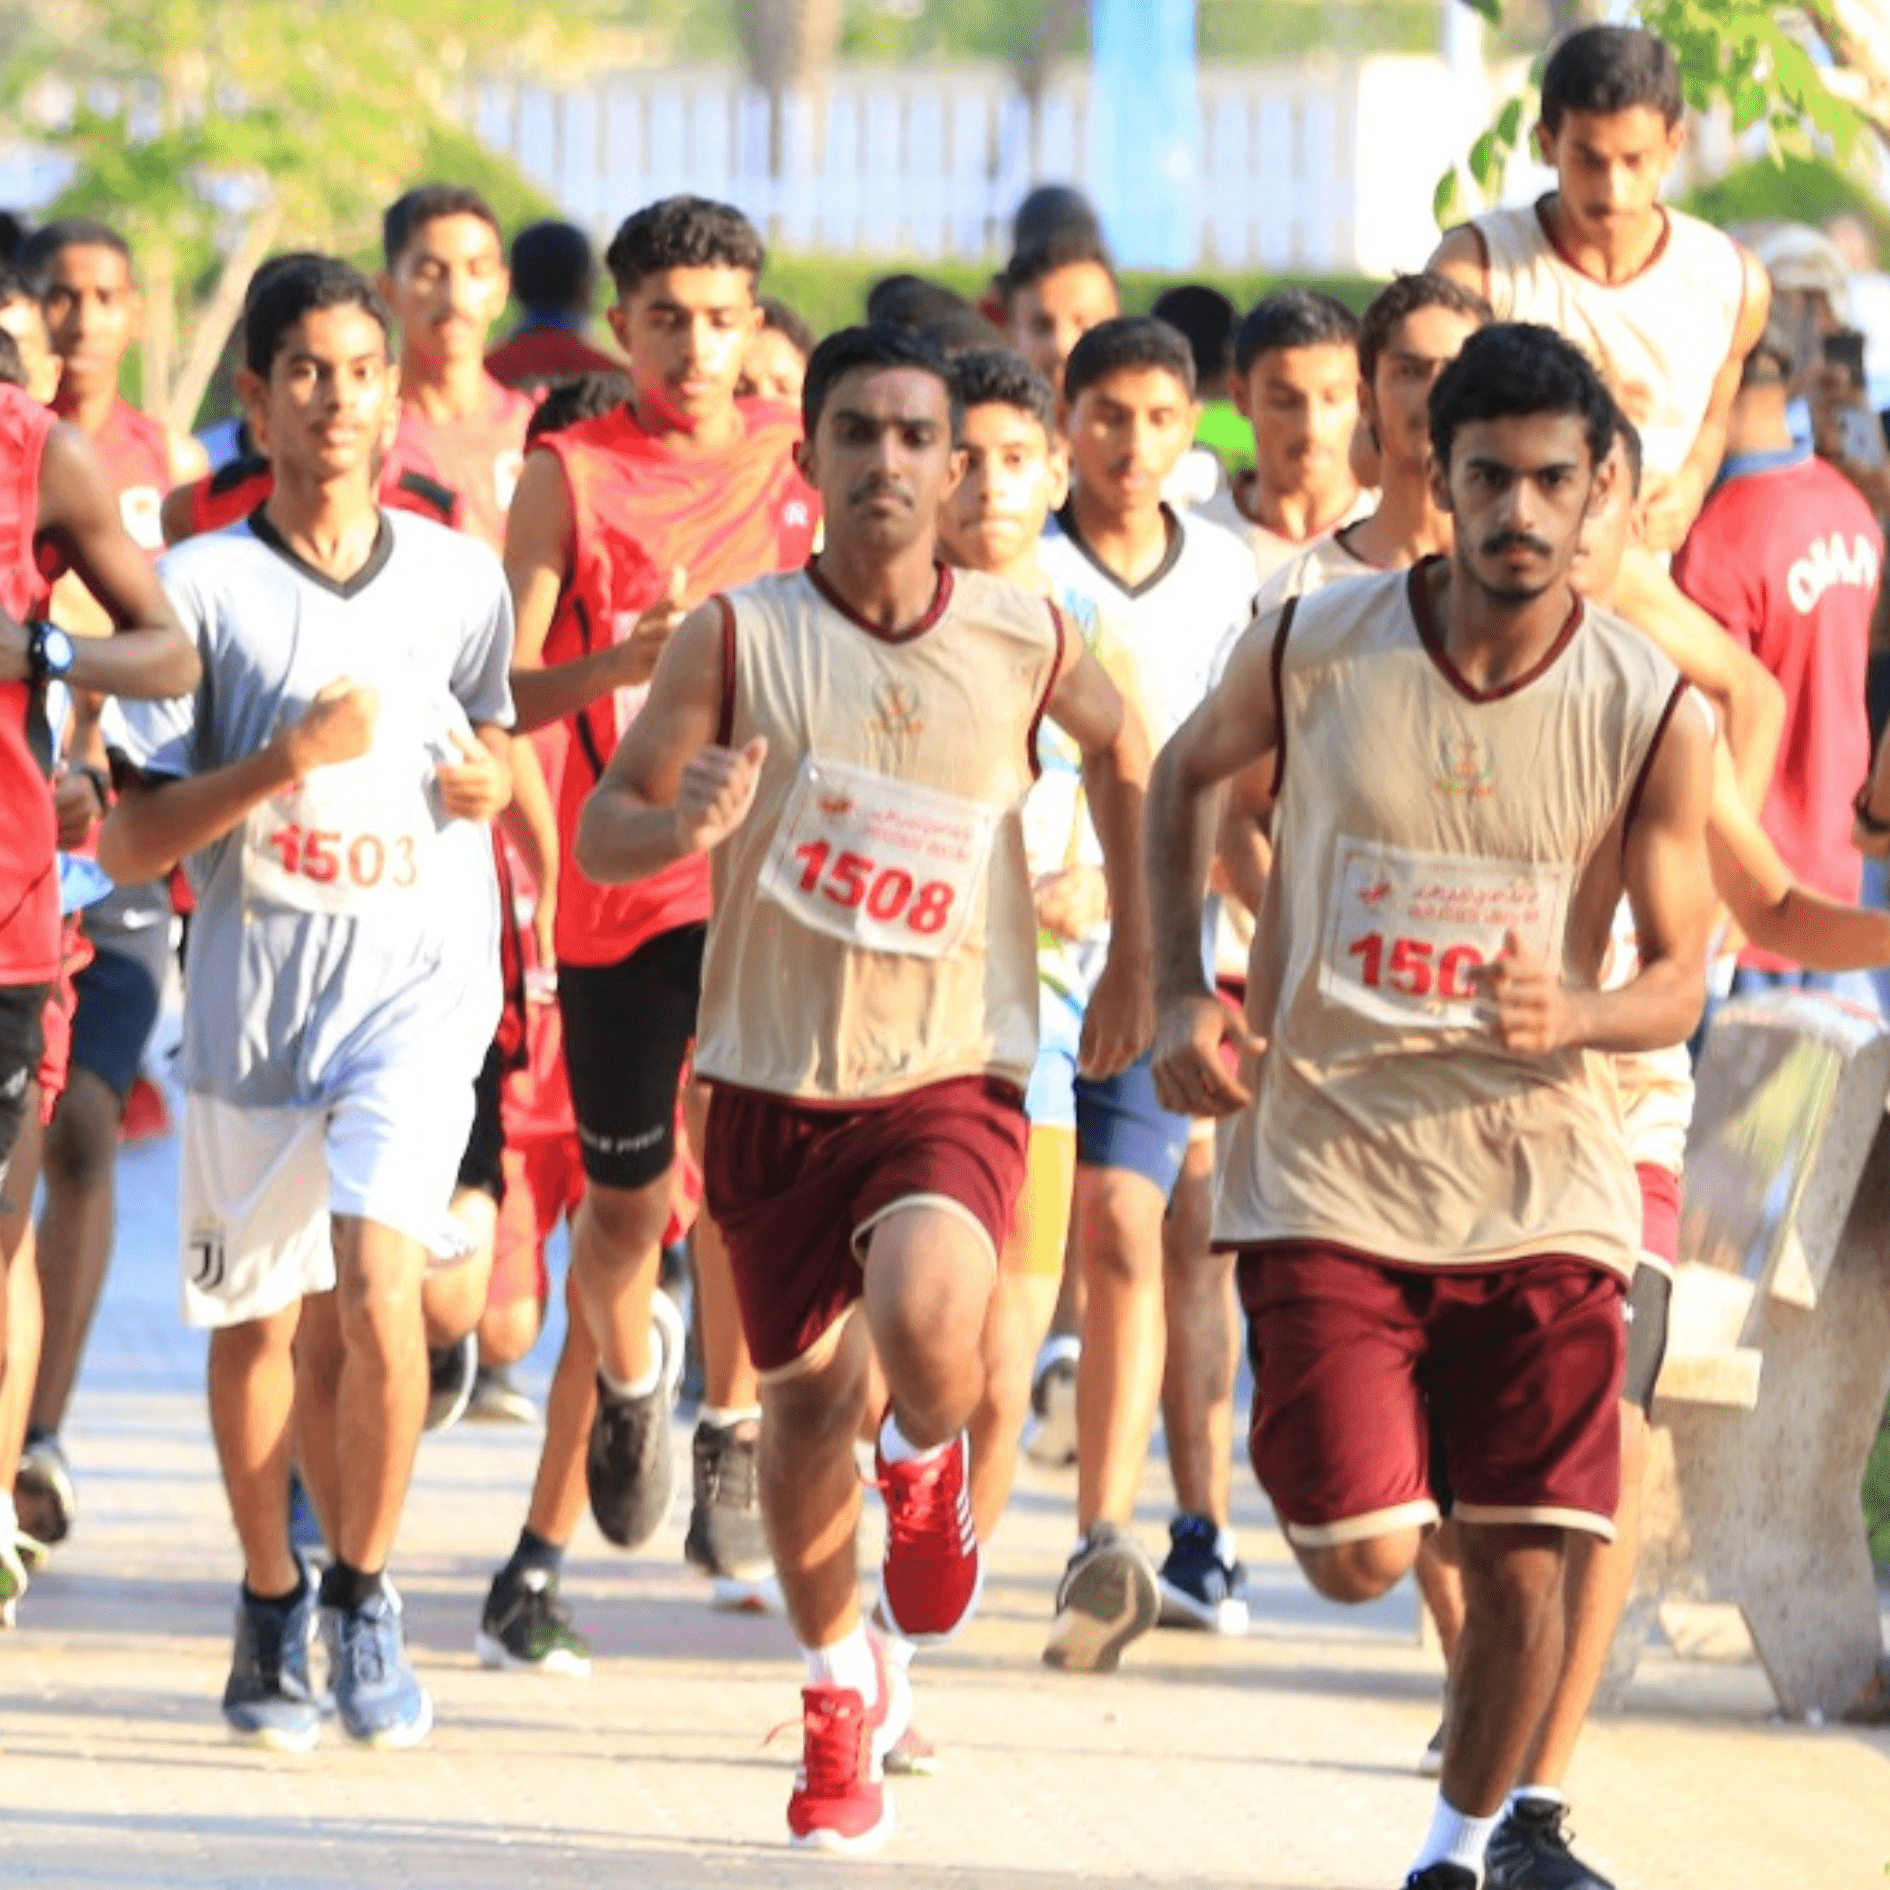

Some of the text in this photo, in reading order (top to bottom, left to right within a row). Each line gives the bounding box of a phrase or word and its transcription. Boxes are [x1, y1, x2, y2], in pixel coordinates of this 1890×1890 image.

[269, 823, 418, 888] 1503
[794, 840, 956, 936] 1508
[1349, 933, 1509, 1001] 150
